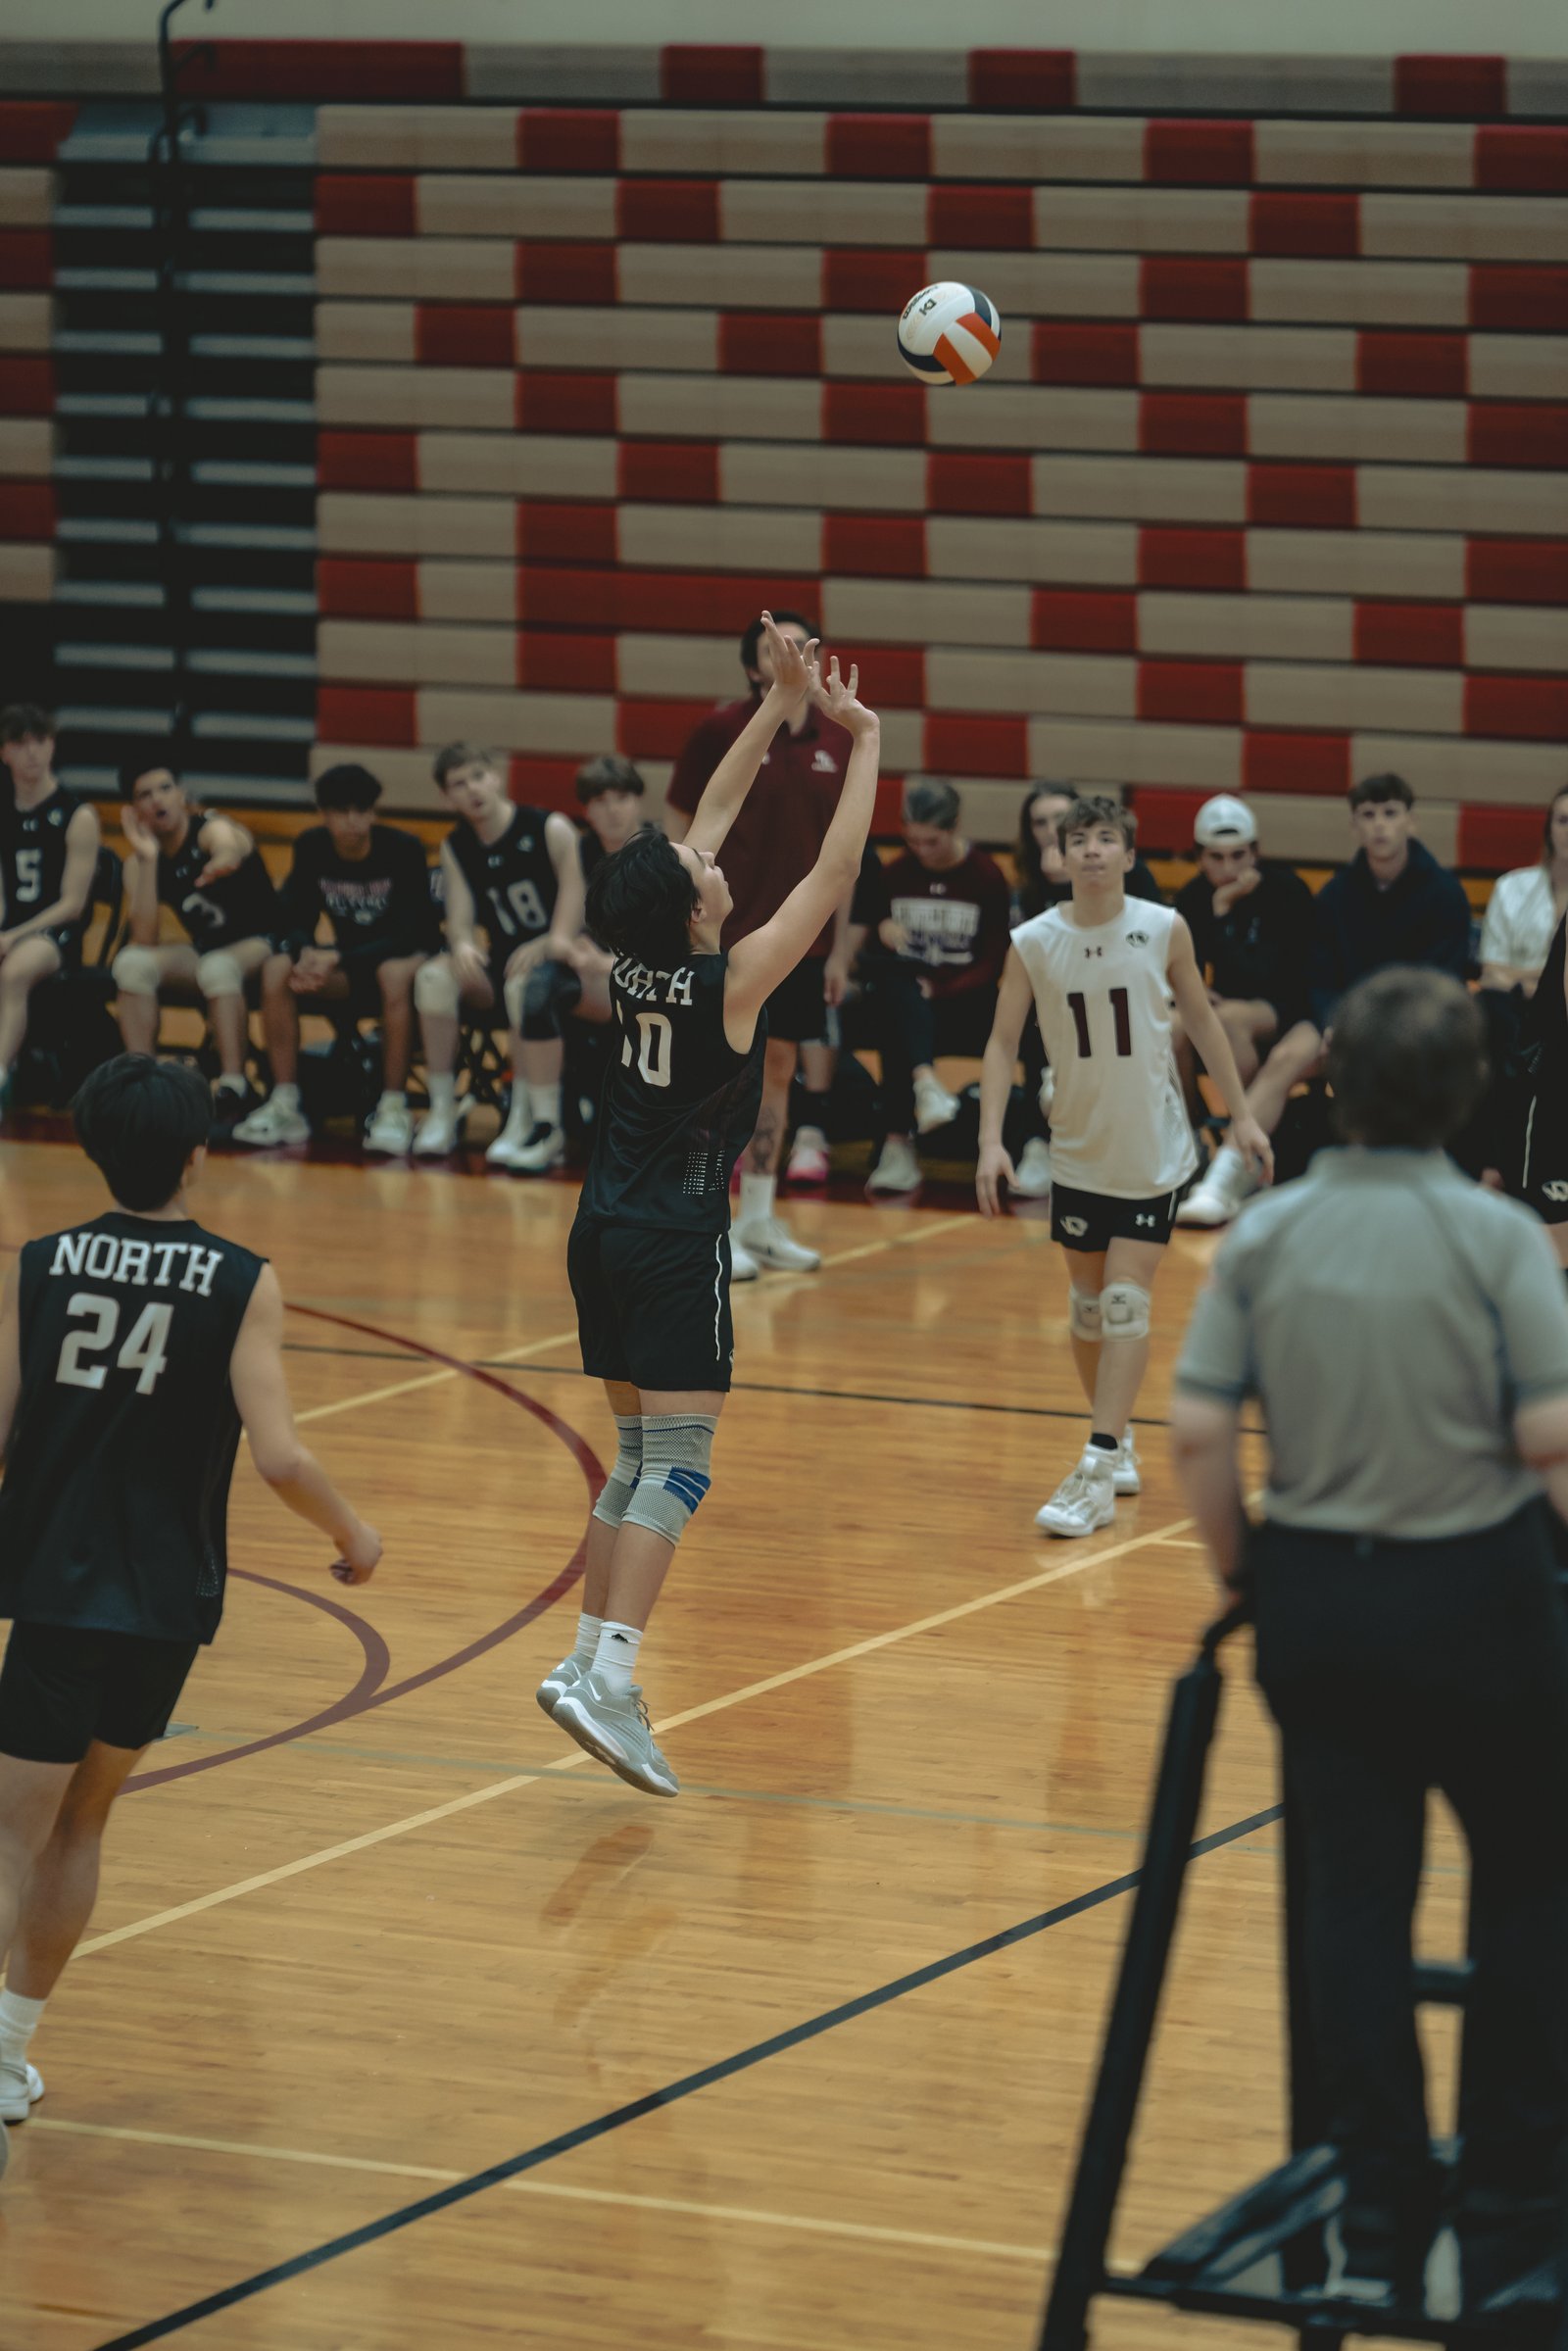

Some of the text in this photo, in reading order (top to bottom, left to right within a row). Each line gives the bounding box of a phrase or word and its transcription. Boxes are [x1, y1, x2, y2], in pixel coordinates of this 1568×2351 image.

[16, 849, 41, 902] 5
[487, 880, 547, 936] 18
[612, 952, 695, 1005] ORTH
[1066, 987, 1131, 1057] 11
[49, 1231, 223, 1297] NORTH
[56, 1292, 174, 1395] 24
